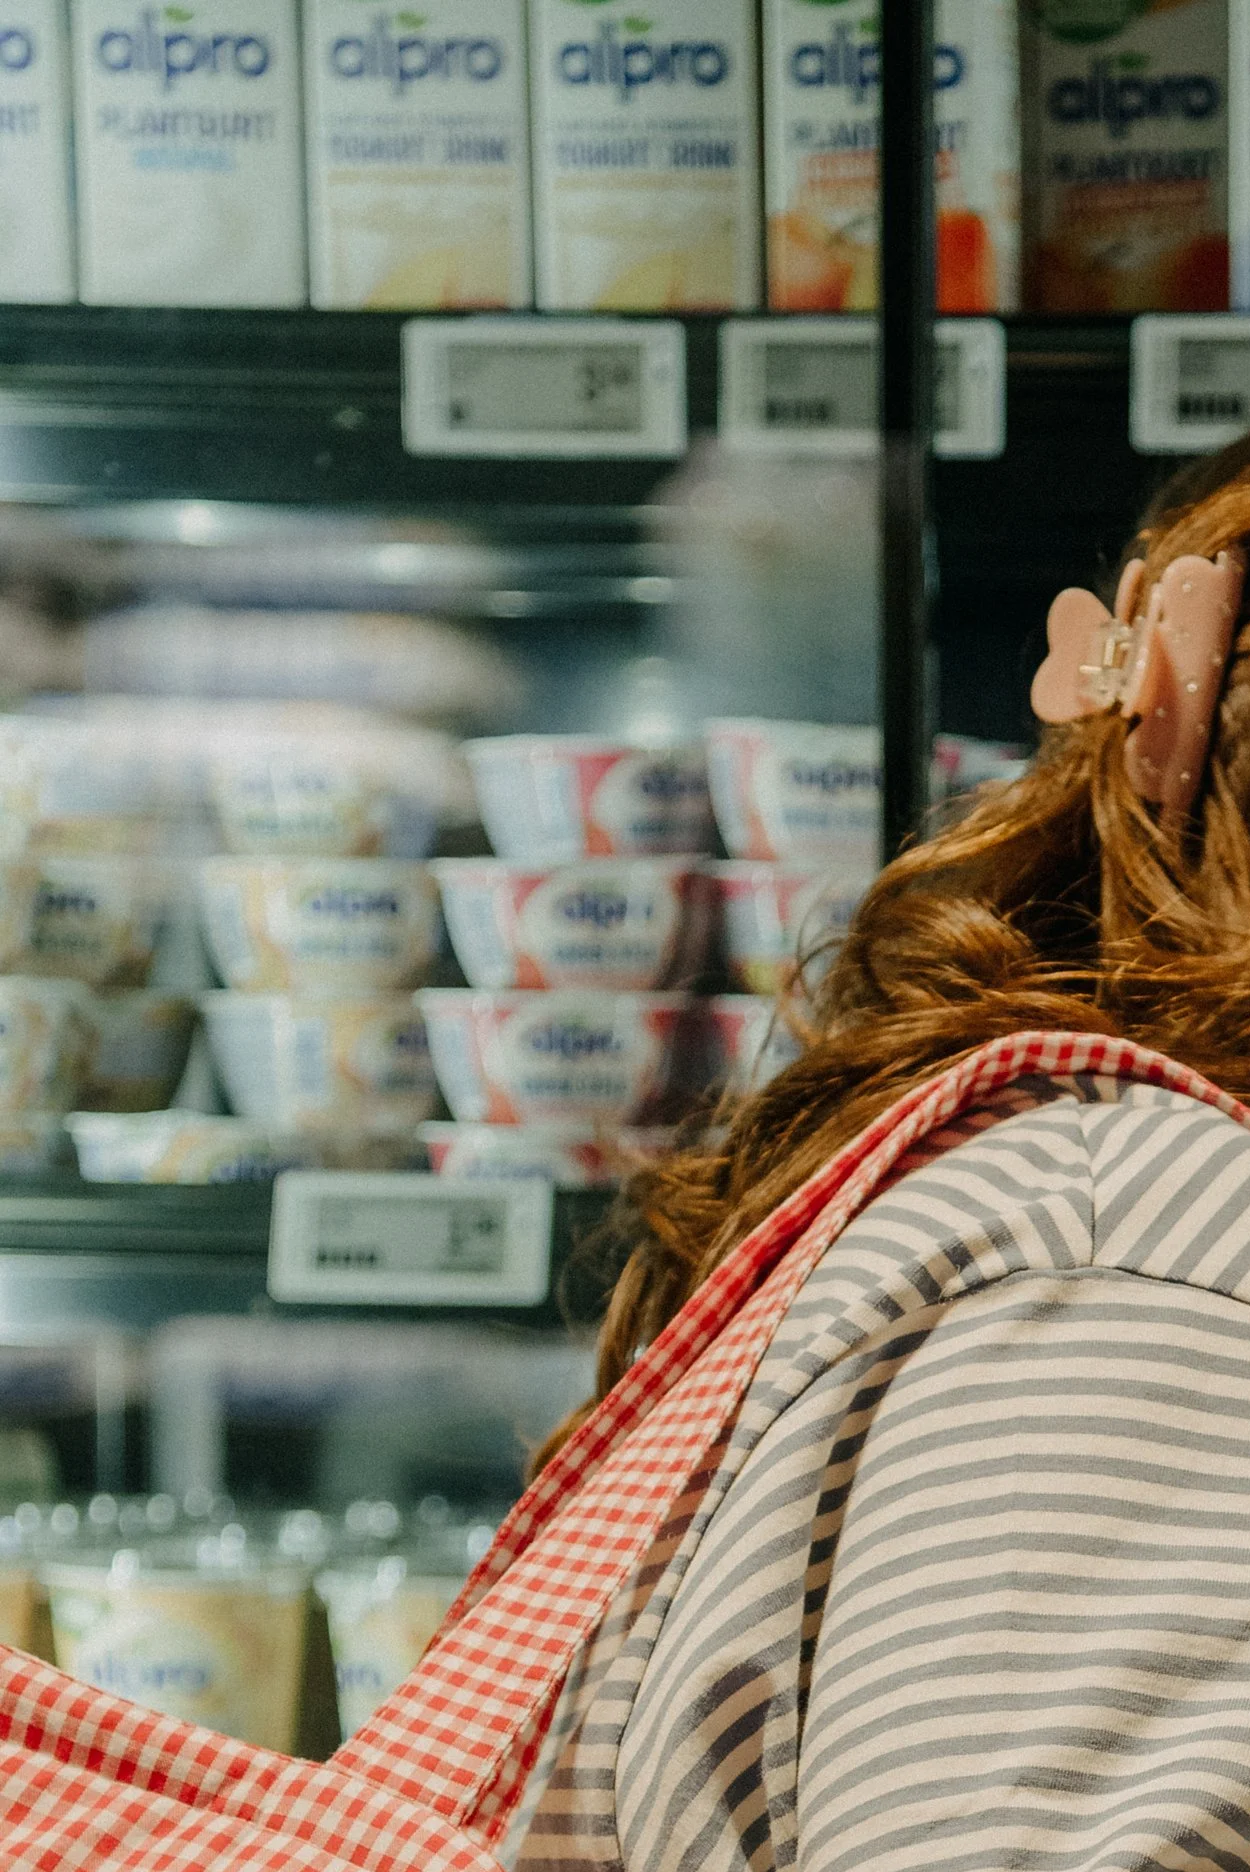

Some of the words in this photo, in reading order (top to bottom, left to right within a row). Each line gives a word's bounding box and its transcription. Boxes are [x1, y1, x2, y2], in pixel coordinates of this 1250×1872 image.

[99, 8, 270, 92] alpro
[331, 14, 500, 98] alpro
[557, 20, 728, 102] alpro
[1050, 55, 1220, 138] alpro
